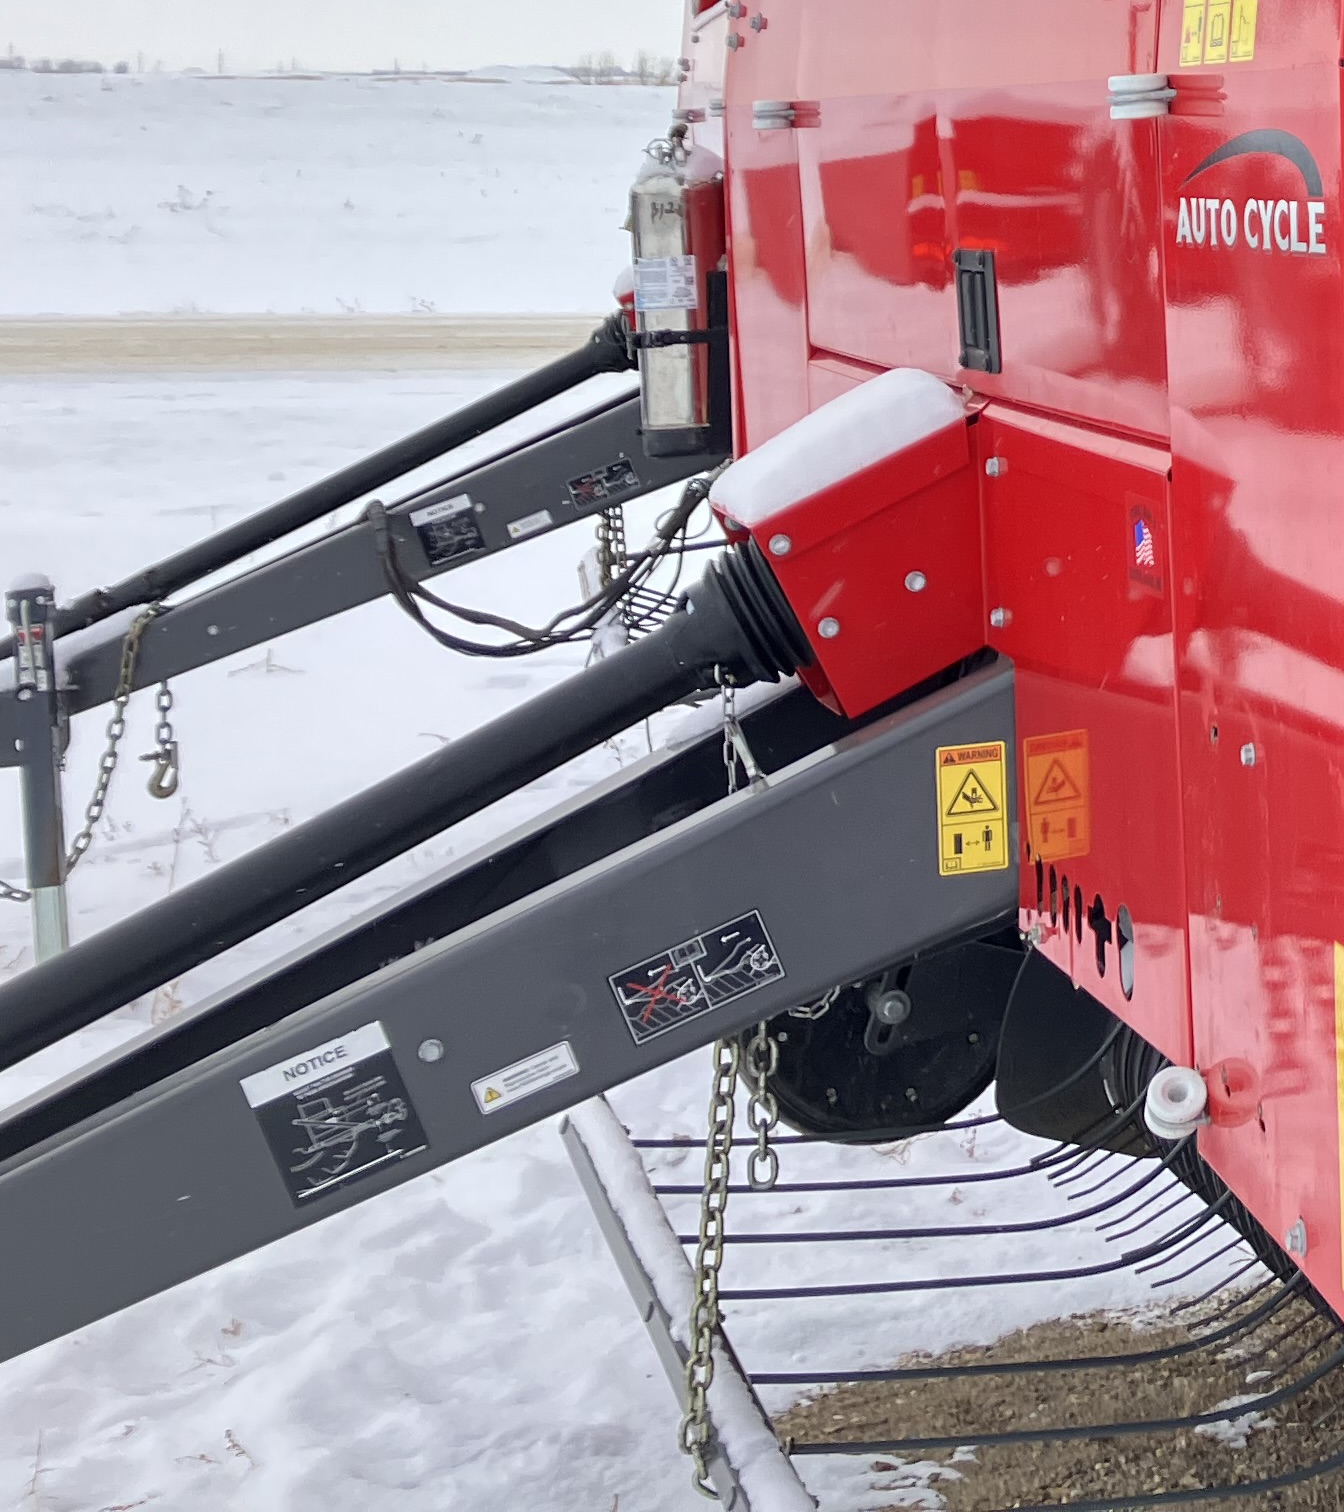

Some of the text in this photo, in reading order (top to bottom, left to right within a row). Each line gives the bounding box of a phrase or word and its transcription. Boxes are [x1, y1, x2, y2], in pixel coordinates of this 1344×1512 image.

[1175, 196, 1327, 255] AUTO CYCLE
[957, 747, 999, 762] WARNING
[283, 1045, 348, 1081] NOTICE
